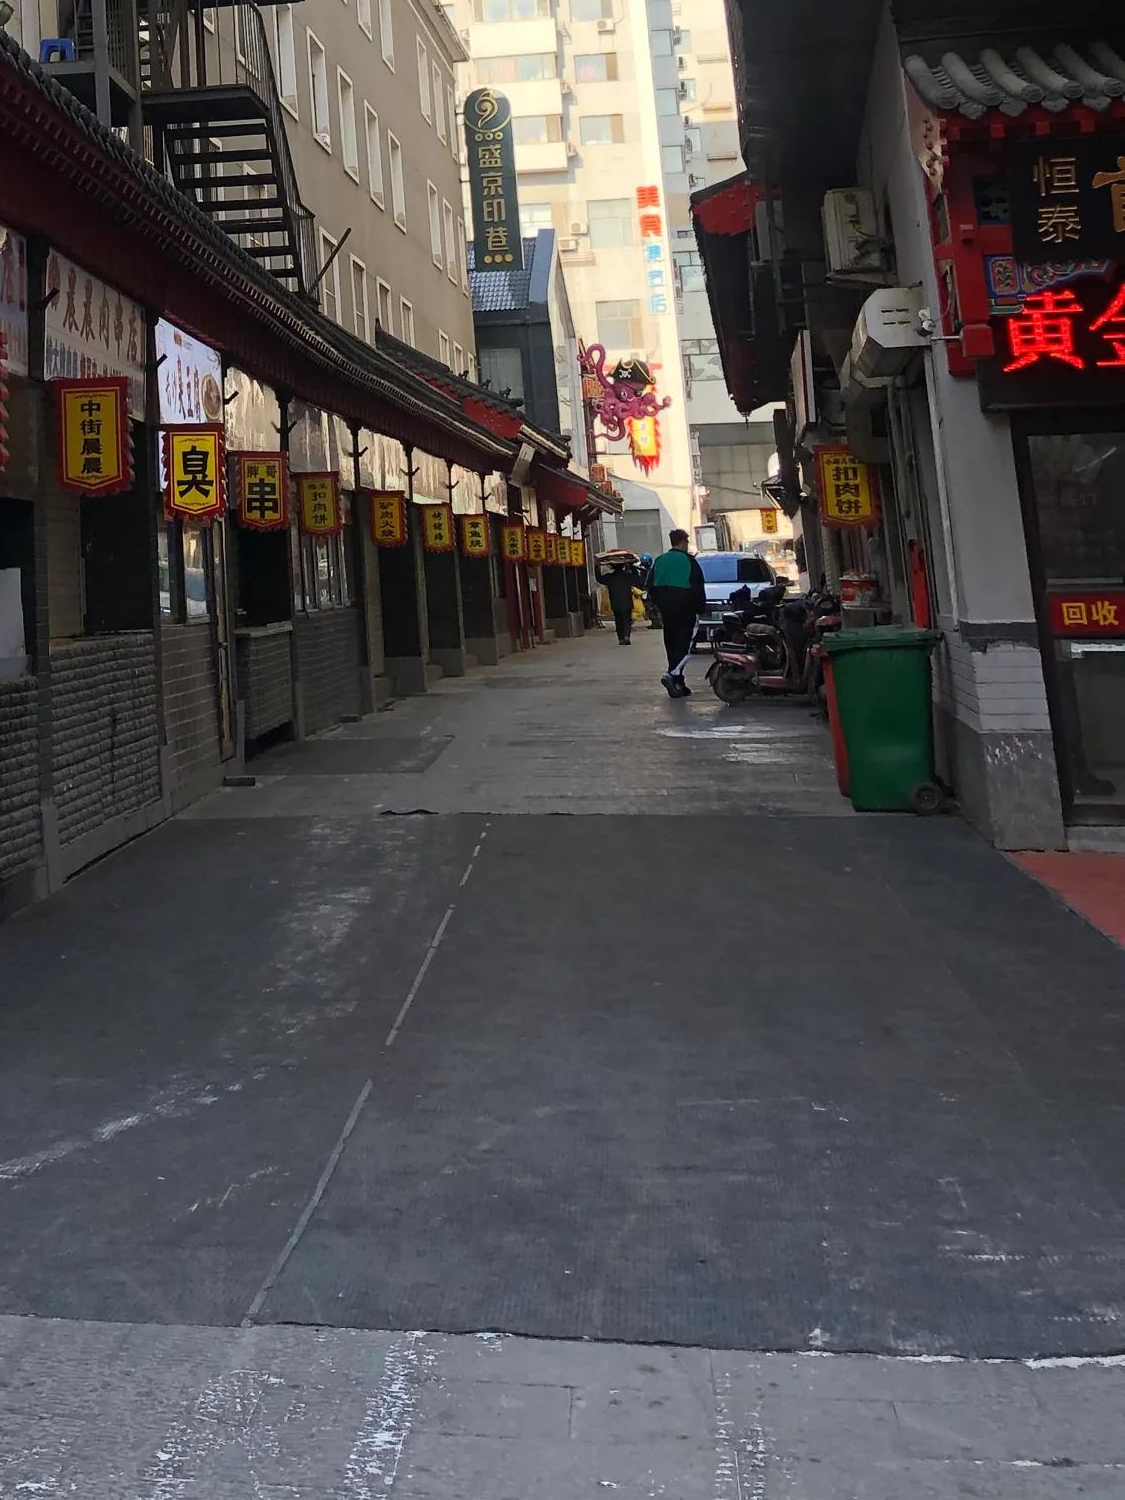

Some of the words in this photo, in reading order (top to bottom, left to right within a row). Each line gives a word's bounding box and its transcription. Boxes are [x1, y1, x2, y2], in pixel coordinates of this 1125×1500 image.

[478, 144, 509, 251] 盛京印巷
[1033, 156, 1082, 243] 恒泰
[80, 400, 103, 475] 中街晨晨
[177, 445, 214, 498] 臭
[832, 466, 863, 514] 扣肉饼
[311, 490, 328, 525] 扣肉饼
[1062, 602, 1118, 626] 回收
